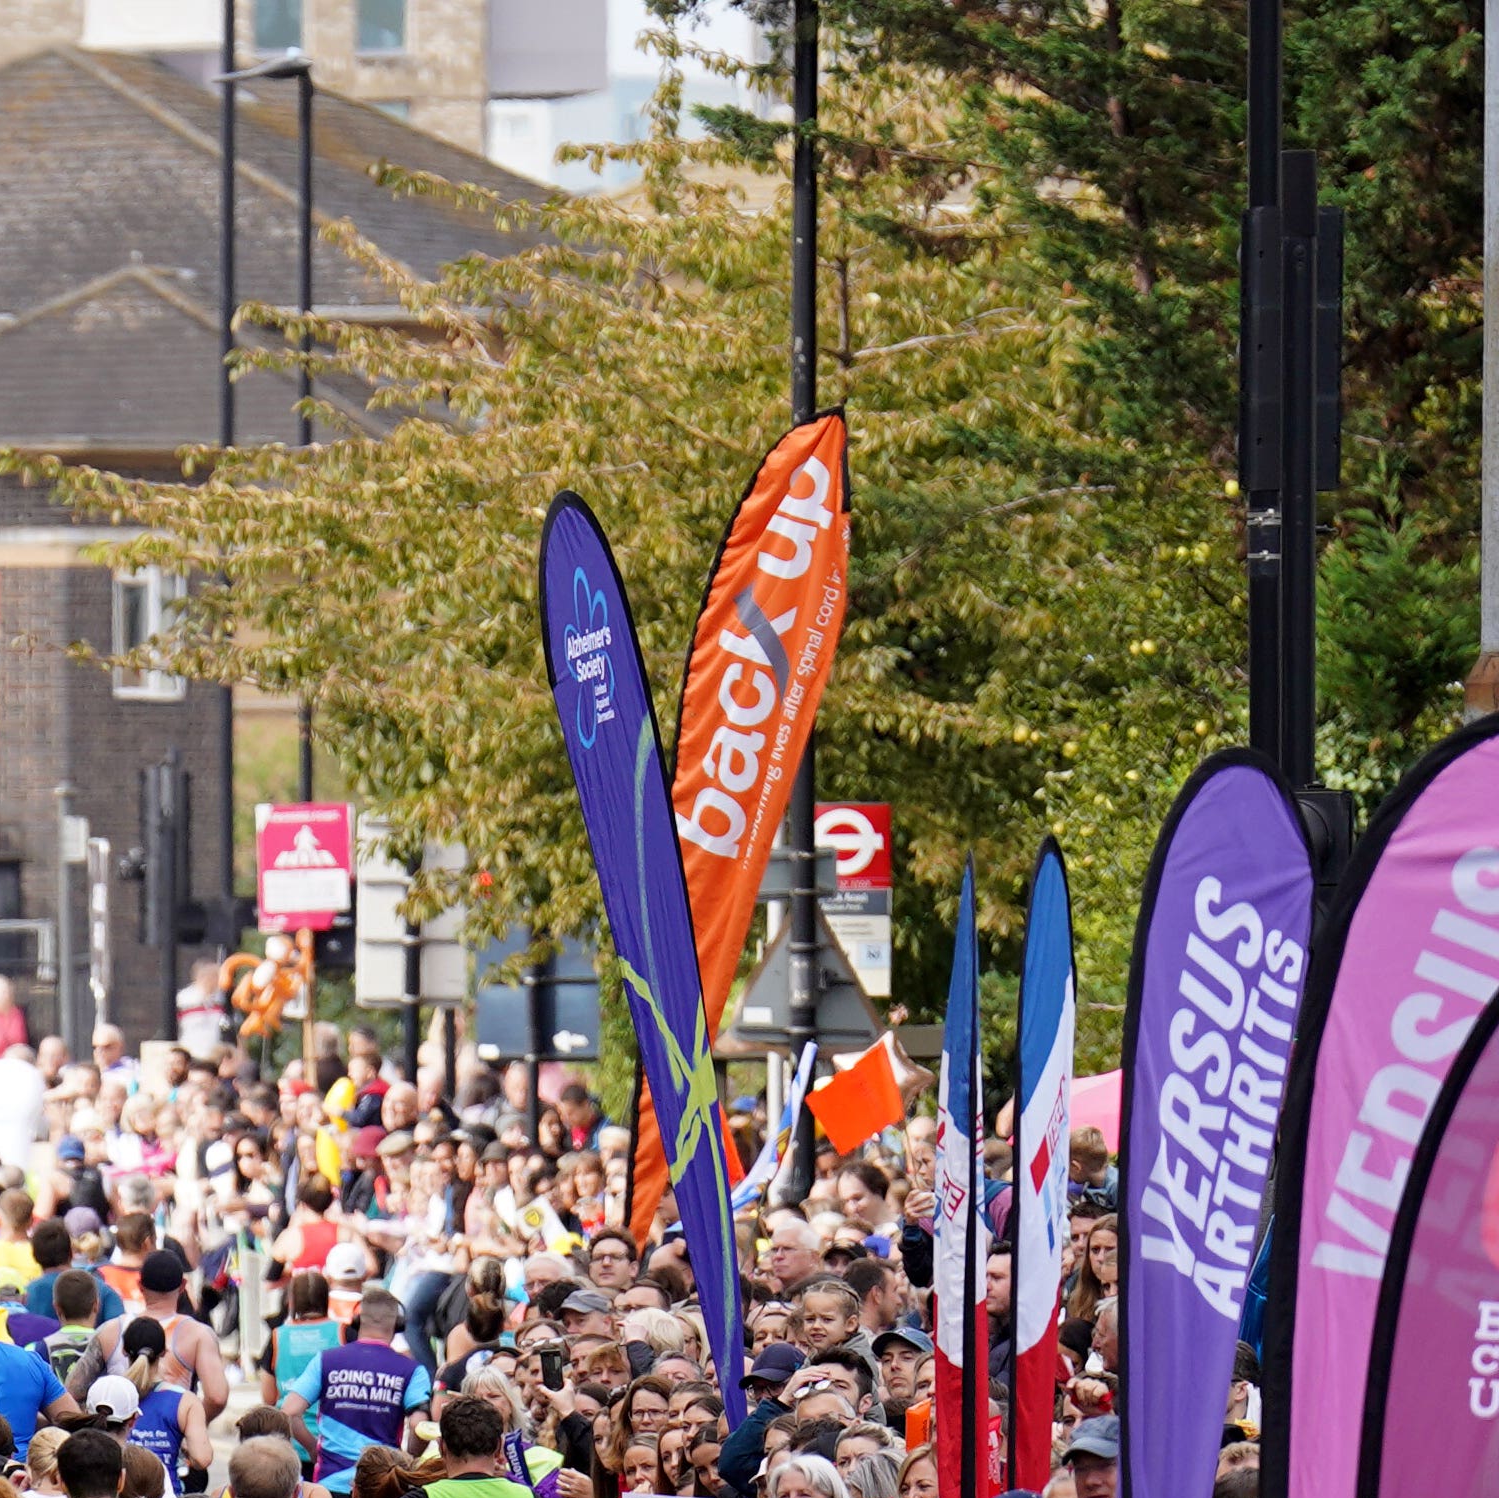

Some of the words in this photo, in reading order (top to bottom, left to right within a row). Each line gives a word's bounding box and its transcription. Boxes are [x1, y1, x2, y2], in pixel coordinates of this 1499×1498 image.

[567, 626, 612, 660] Alzheimer's
[675, 605, 797, 859] back
[757, 455, 832, 579] up
[783, 680, 805, 721] after
[797, 627, 824, 677] spinal
[815, 585, 839, 626] cord
[576, 653, 605, 683] Society
[1141, 875, 1264, 1277] VERSUS
[1193, 929, 1304, 1321] ARTHRITIS
[326, 1384, 368, 1400] EXTRA
[370, 1388, 402, 1405] MILE
[328, 1369, 374, 1386] GOING
[376, 1373, 404, 1389] THE
[506, 1442, 524, 1480] entia
